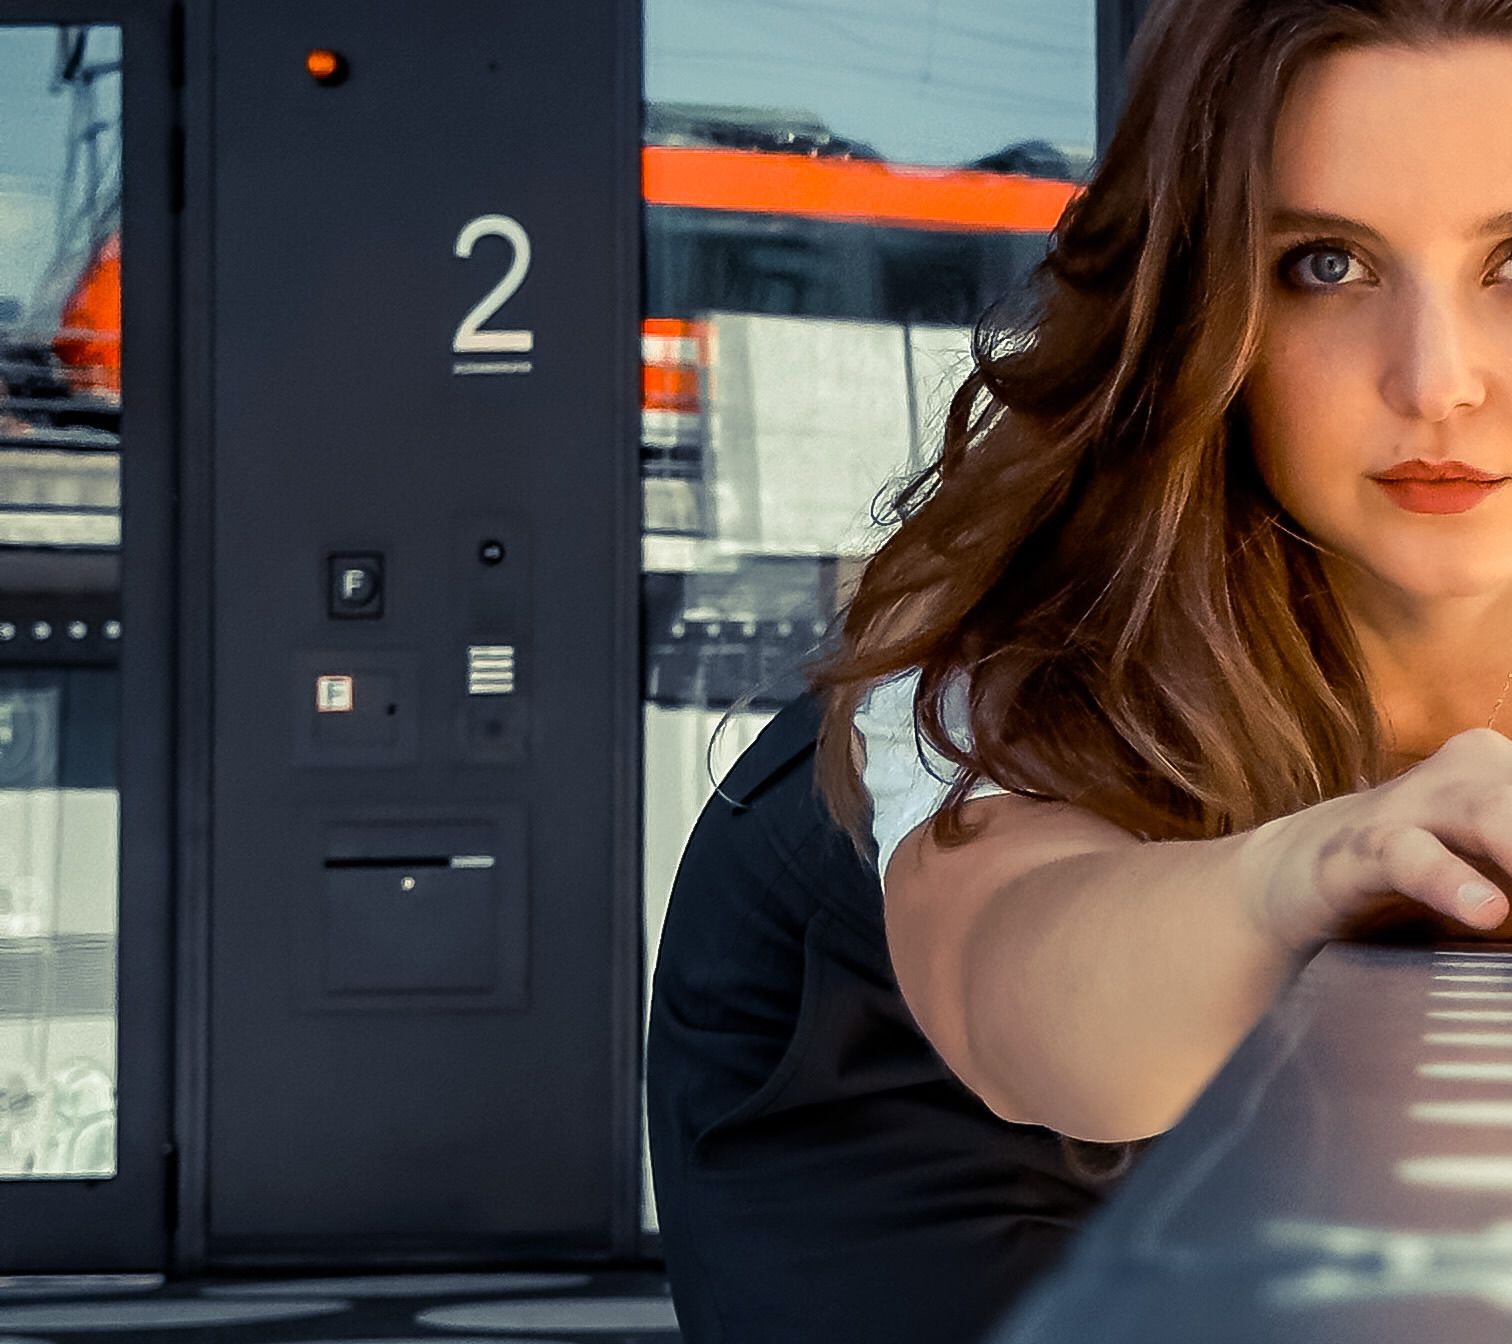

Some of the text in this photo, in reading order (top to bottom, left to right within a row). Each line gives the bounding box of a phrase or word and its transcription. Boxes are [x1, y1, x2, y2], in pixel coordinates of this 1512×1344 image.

[452, 213, 534, 355] 2
[342, 569, 364, 600] F
[327, 682, 345, 705] F
